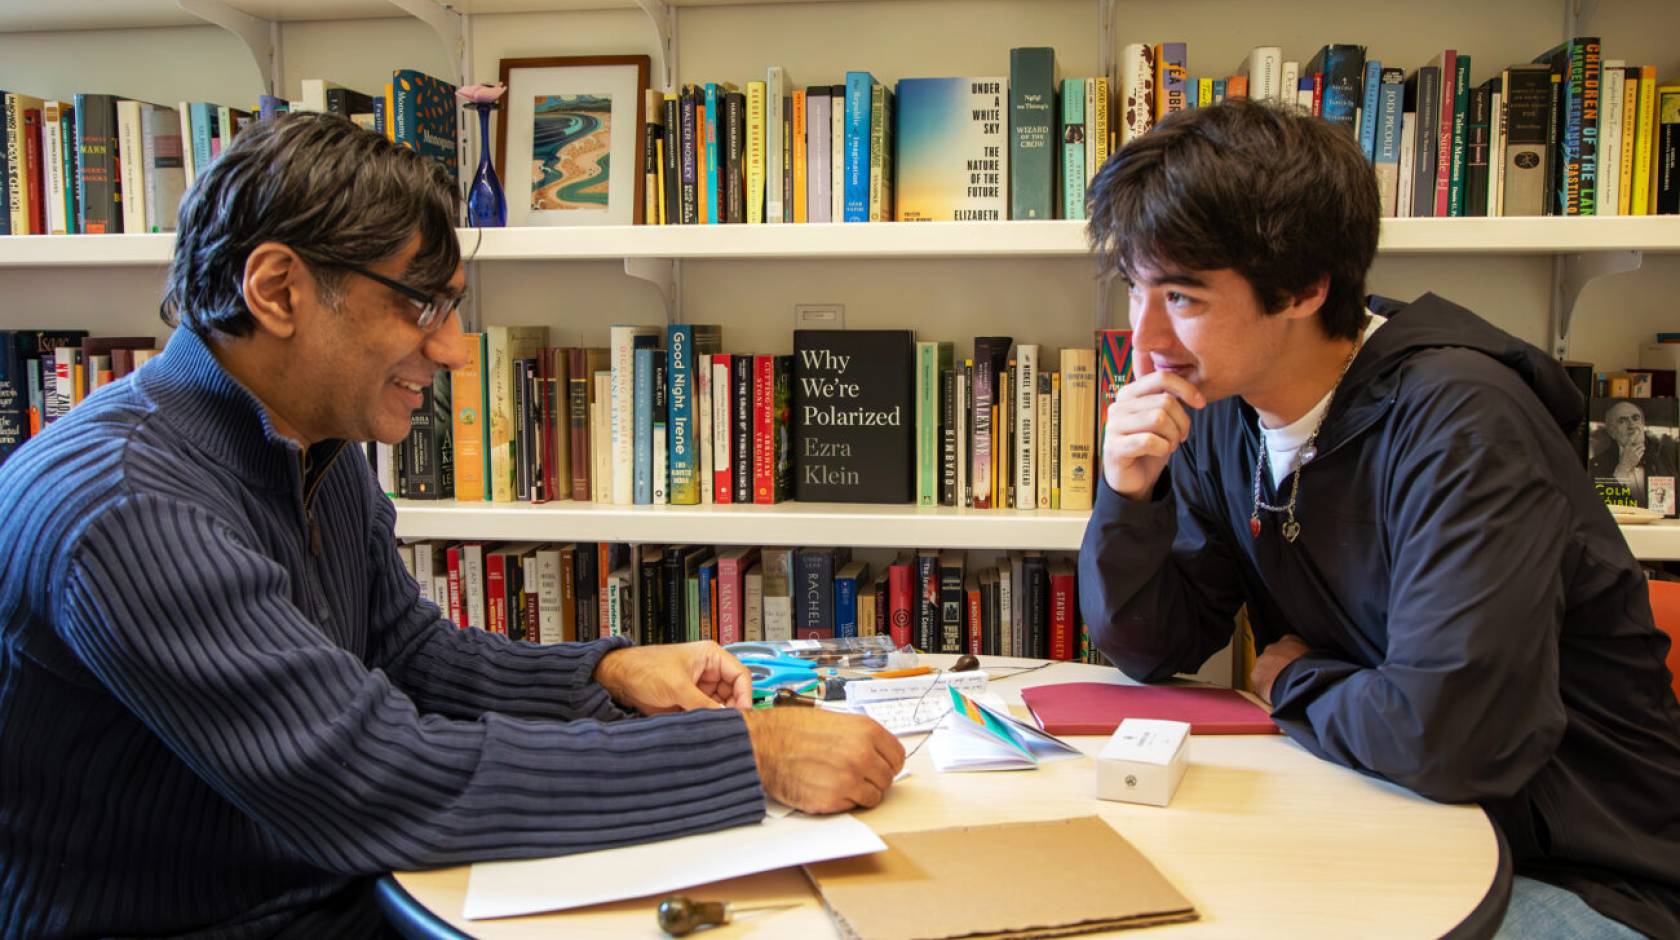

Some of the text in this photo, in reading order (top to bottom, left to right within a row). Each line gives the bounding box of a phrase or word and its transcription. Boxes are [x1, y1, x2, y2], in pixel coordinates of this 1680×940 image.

[1571, 45, 1584, 94] MARCELO
[972, 83, 1000, 93] UNDER
[1169, 61, 1185, 113] TÉA OBR
[852, 92, 861, 126] Republic
[995, 97, 999, 107] A
[972, 110, 1000, 121] WHITE
[1383, 89, 1397, 157] JODI PICOULT
[1457, 112, 1465, 134] Tales
[984, 123, 1000, 134] SKY
[1457, 136, 1464, 144] of
[1581, 44, 1600, 216] CHILDREN OF THE LAN
[80, 145, 106, 153] MANN
[684, 143, 692, 178] MOSLEY
[852, 137, 860, 185] Imagination
[984, 147, 999, 157] THE
[967, 160, 999, 170] NATURE
[1454, 146, 1464, 181] Madness
[970, 174, 999, 184] OF THE
[1567, 163, 1579, 213] CASTILLO
[967, 187, 999, 198] FUTURE
[954, 209, 998, 221] ELIZABETH
[674, 332, 685, 369] Good
[800, 349, 850, 374] Why
[672, 374, 686, 411] Night,
[801, 377, 859, 398] We're
[620, 399, 627, 413] TO
[803, 405, 900, 427] Polarized
[676, 417, 686, 455] Irene
[977, 395, 990, 456] VALENTINE
[1022, 365, 1031, 487] NICKEL BOYS COLSON WHITEHEAD
[804, 438, 851, 457] Ezra
[804, 465, 859, 485] Klein
[469, 561, 477, 585] LEAN
[808, 573, 820, 627] RACHEL
[722, 584, 733, 643] MAN IS WO
[1056, 592, 1065, 658] STATUS ANXIETY
